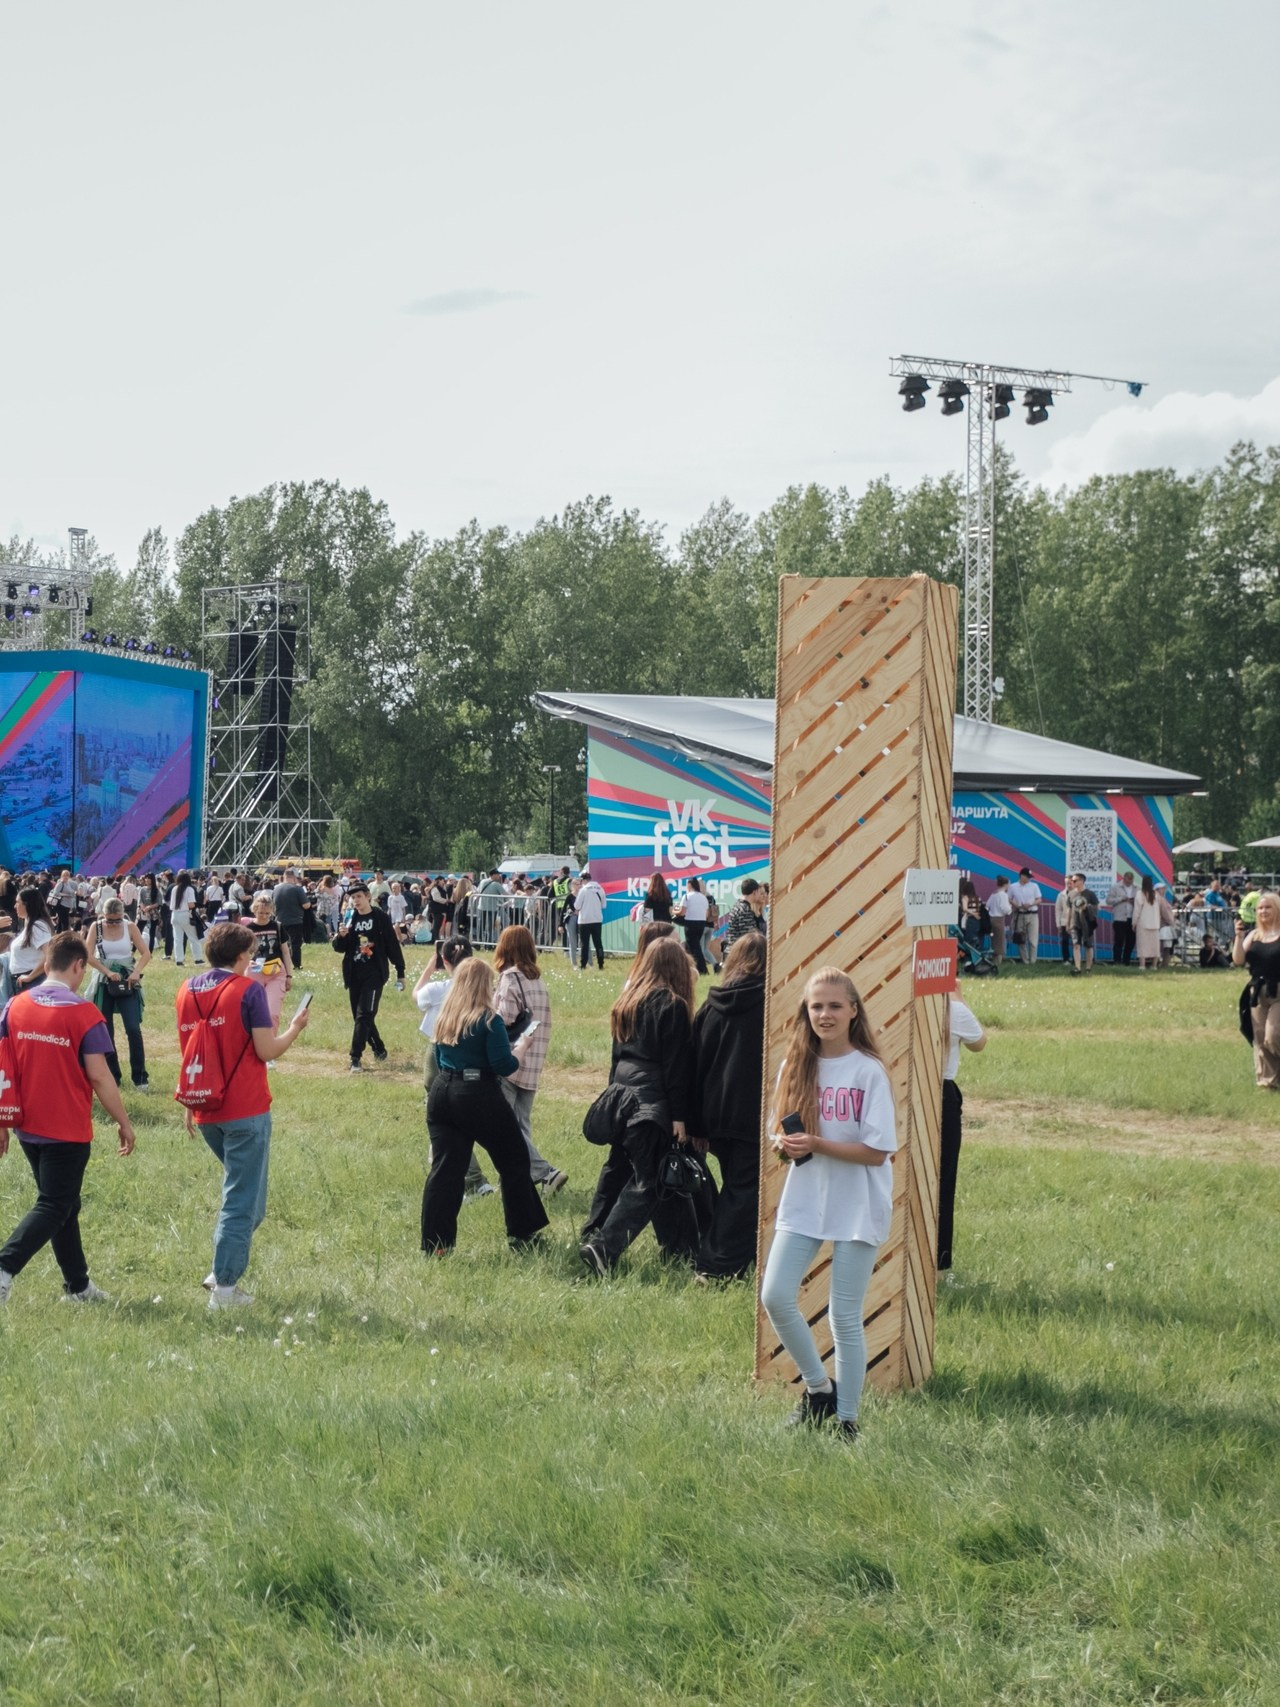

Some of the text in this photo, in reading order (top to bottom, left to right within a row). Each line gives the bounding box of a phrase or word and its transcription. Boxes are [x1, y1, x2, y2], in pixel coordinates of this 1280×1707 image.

[666, 799, 718, 832] VK
[653, 821, 736, 868] fest
[17, 1031, 70, 1048] @volmedic24
